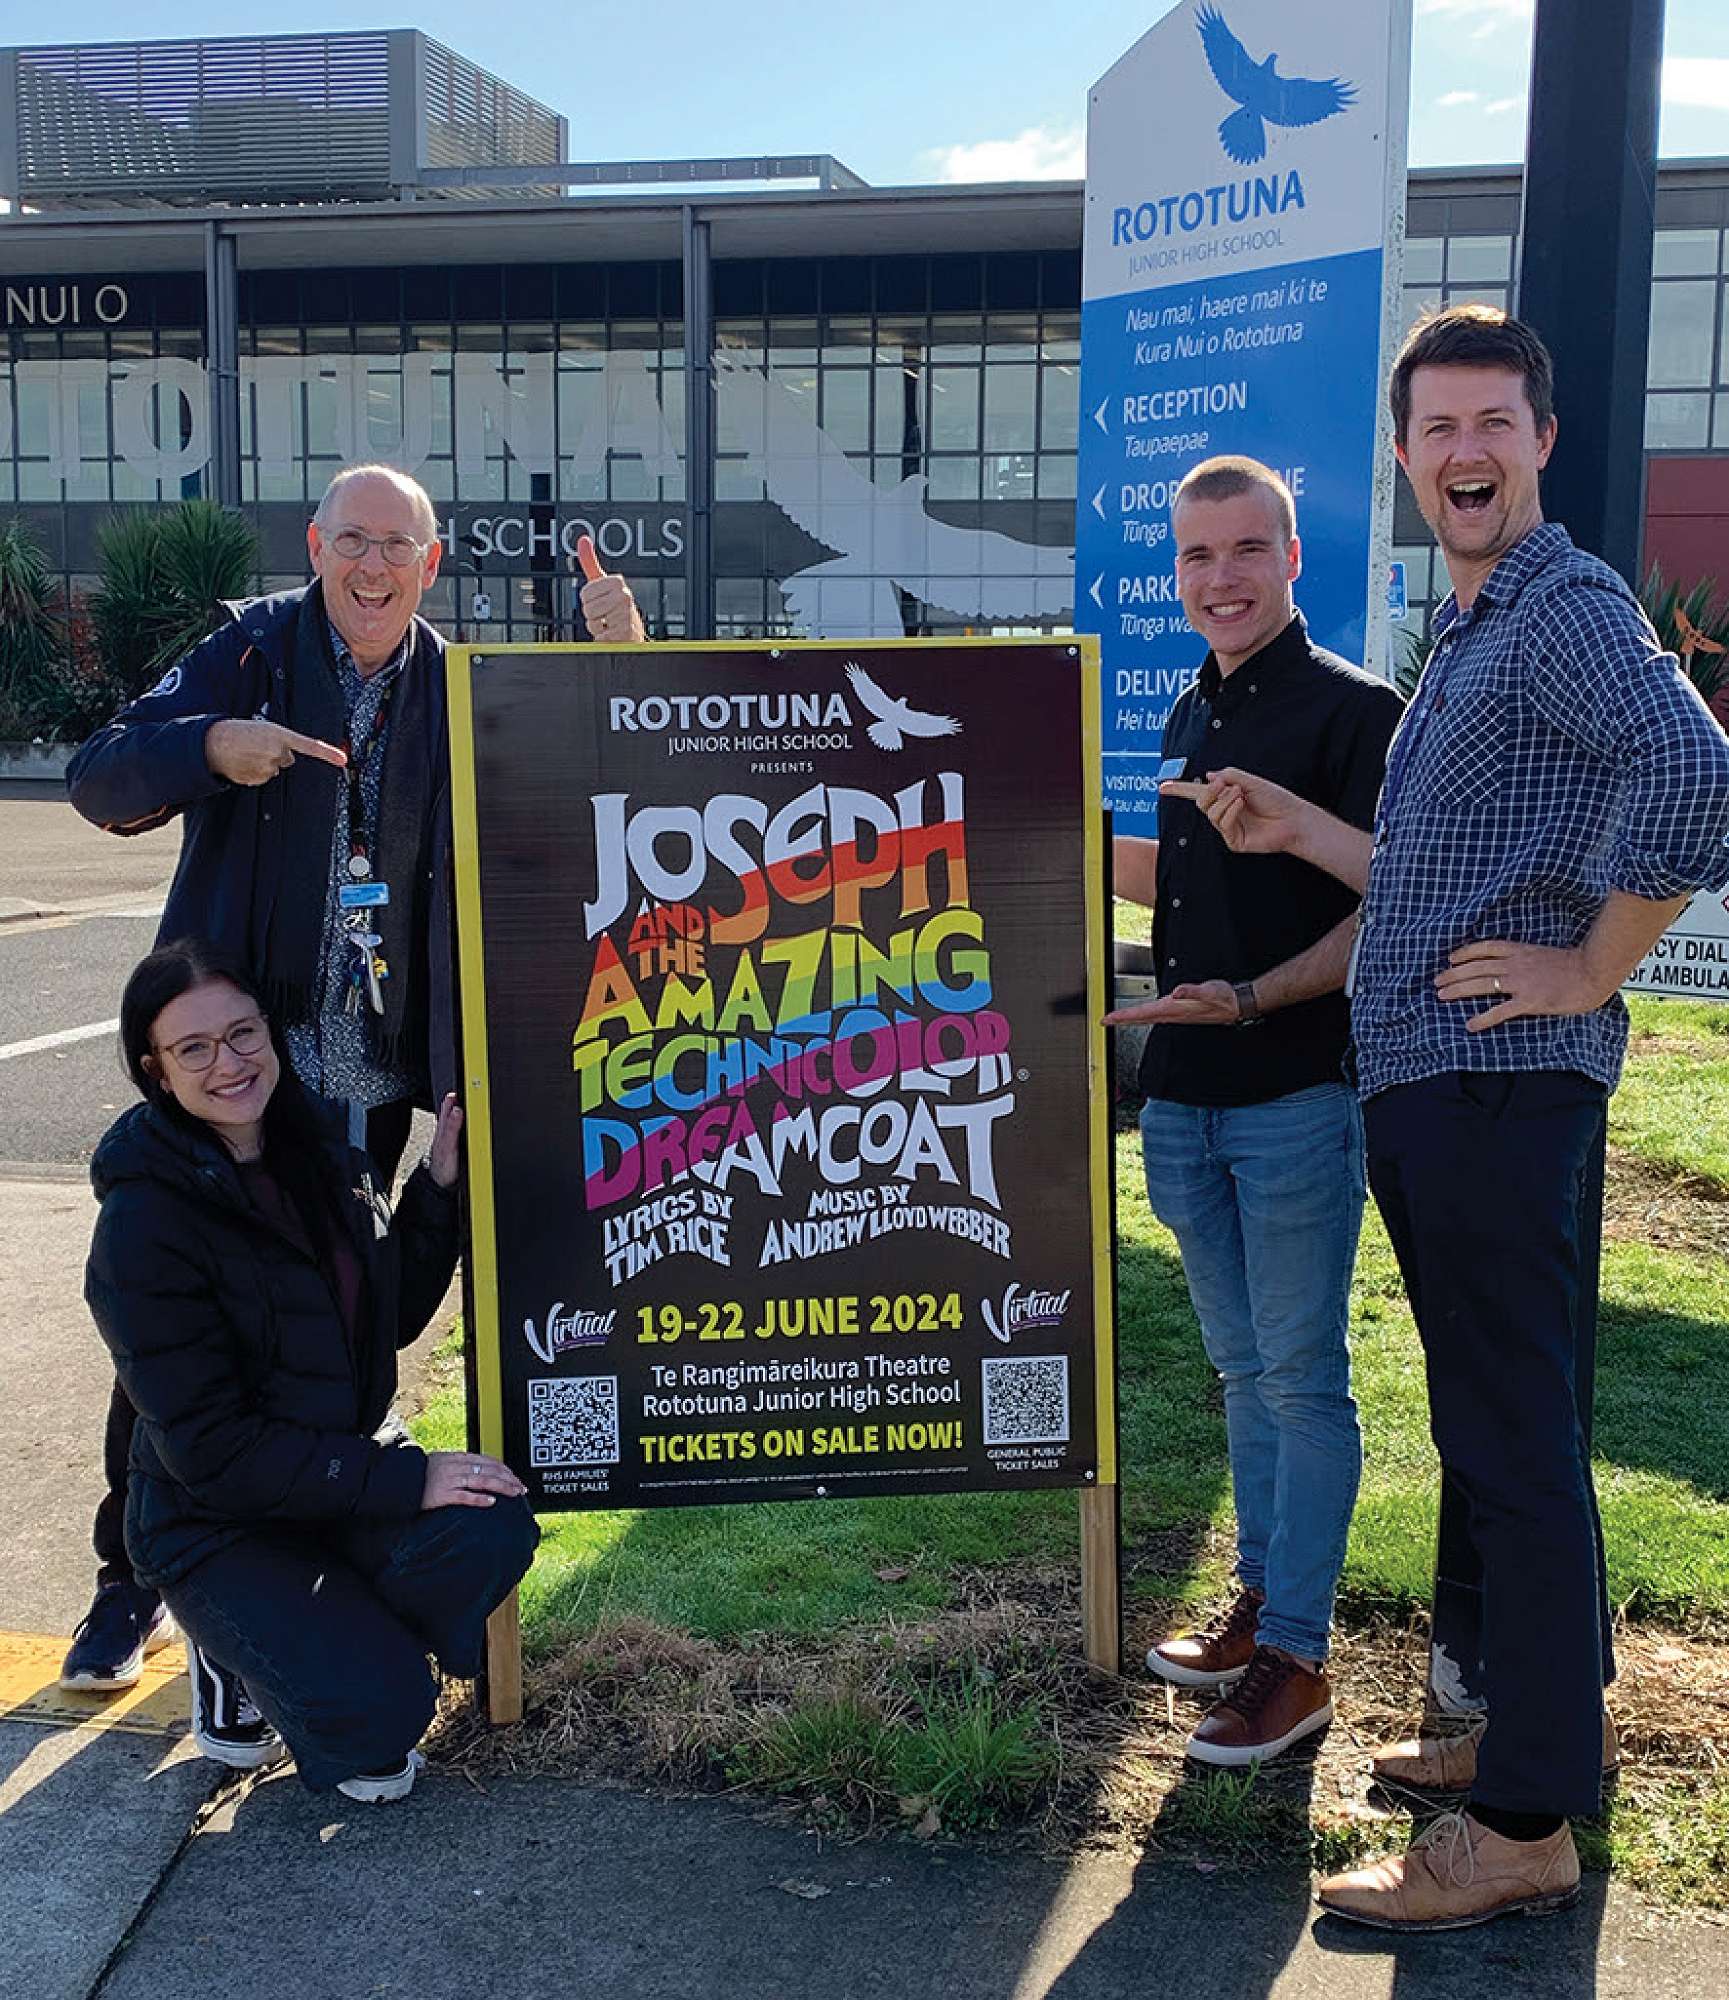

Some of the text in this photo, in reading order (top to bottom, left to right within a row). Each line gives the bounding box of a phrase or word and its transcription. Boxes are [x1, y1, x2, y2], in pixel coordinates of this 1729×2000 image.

[1112, 169, 1306, 247] ROTOTUNA
[1129, 228, 1285, 279] JUNIOR HIGH SCHOOL
[6, 284, 128, 324] NUI O
[1126, 309, 1158, 332] Nau
[1200, 295, 1248, 320] haere
[1251, 281, 1286, 312] mai
[1308, 280, 1329, 303] te
[1134, 321, 1304, 365] Kura Nui o Rototuna
[1123, 382, 1248, 424] RECEPTION
[1124, 430, 1209, 459] Taupaepae
[471, 518, 685, 557] SCHOOLS
[1122, 520, 1168, 548] Tūnga
[1120, 614, 1166, 642] Tūnga
[610, 694, 853, 731] ROTOTUNA
[1116, 707, 1144, 731] Hei
[669, 733, 853, 756] JUNIOR HIGH SCHOOL
[751, 760, 814, 774] PRESENTS
[583, 772, 969, 944] JOSEPH
[628, 896, 705, 942] AND
[628, 938, 707, 982] THE
[1649, 936, 1728, 962] CY DIAL
[573, 909, 994, 1046] AMAZING
[573, 1007, 1012, 1113] TECHNICOLOR
[581, 1092, 1016, 1210] DREAMCOAT
[603, 1187, 733, 1256] LYRICS BY
[807, 1185, 911, 1218] MUSIC BY
[604, 1218, 731, 1287] TIM RICE
[758, 1205, 1012, 1268] ANDREW LLOYD WEBBER
[524, 1303, 617, 1364] Virtual
[637, 1292, 963, 1343] 19-22 JUNE 2024
[981, 1282, 1072, 1344] Virtual
[651, 1354, 951, 1390] Te Rangimāreikura Theatre
[643, 1379, 961, 1417] Rototuna Junior High School
[639, 1420, 963, 1464] TICKETS ON SALE NOW!
